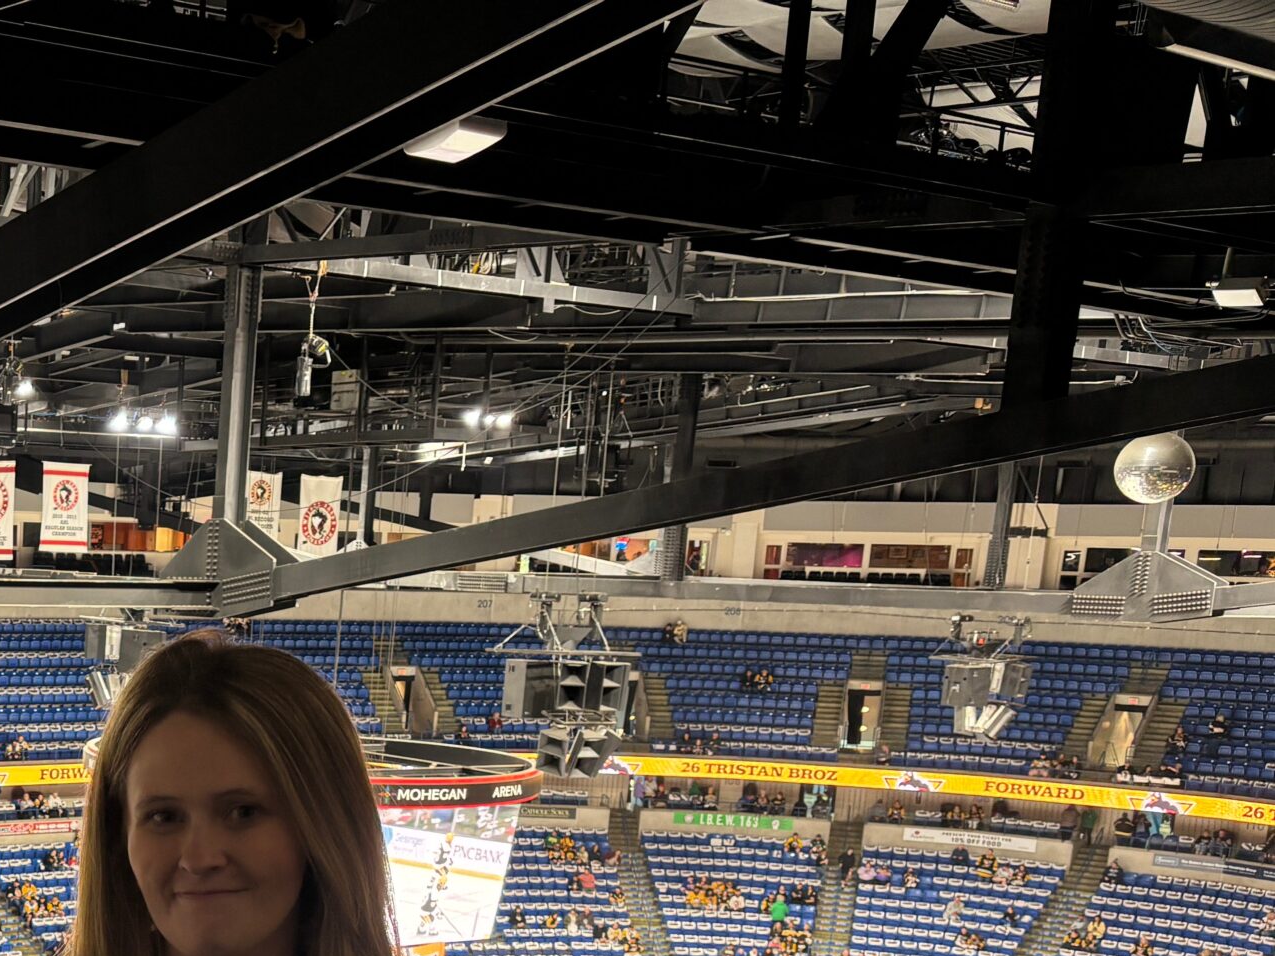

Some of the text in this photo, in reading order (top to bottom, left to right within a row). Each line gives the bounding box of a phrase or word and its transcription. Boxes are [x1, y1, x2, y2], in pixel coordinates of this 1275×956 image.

[477, 600, 493, 609] 207
[680, 762, 838, 781] 26 TRISTAN BROZ
[396, 784, 523, 801] MOHEGAN ARENA
[983, 780, 1085, 801] FORWARD
[1241, 805, 1265, 820] 26
[740, 815, 759, 828] 163
[981, 839, 1003, 848] FOOD
